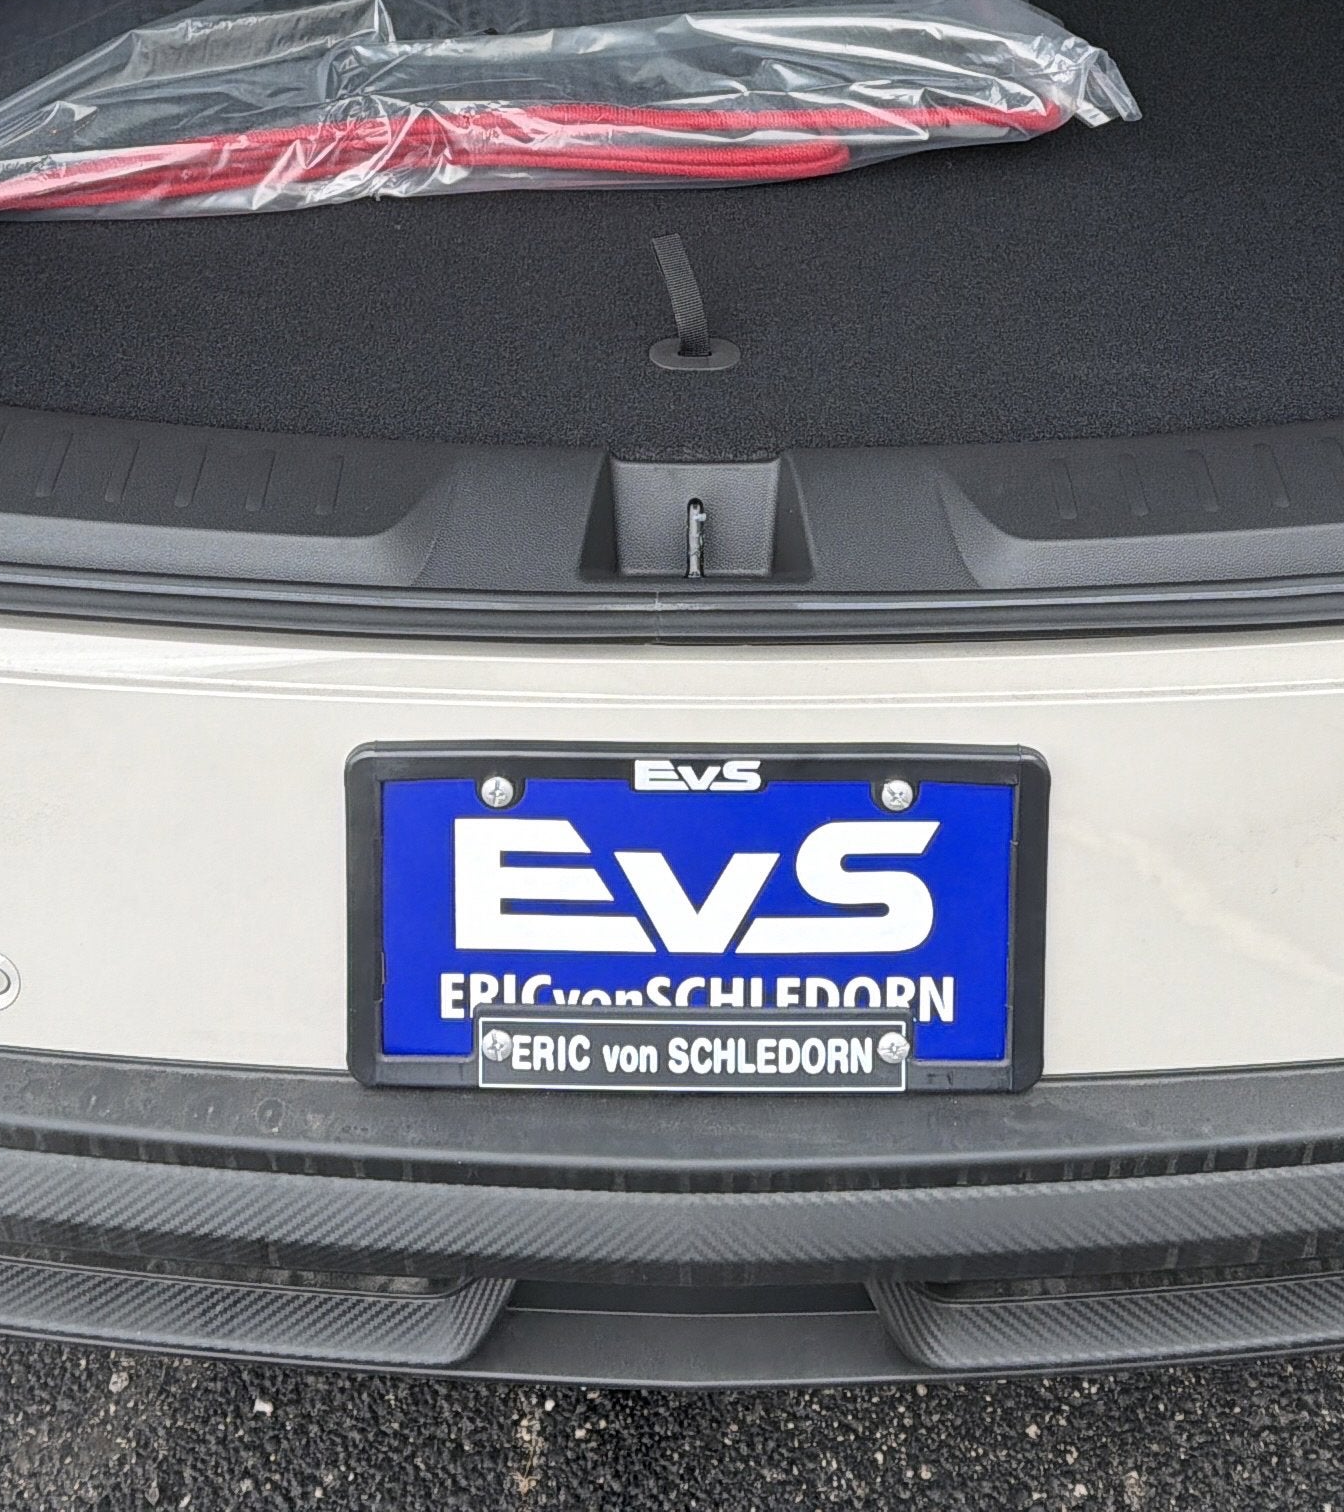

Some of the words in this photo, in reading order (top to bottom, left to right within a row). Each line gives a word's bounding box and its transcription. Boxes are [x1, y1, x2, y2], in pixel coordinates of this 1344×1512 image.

[511, 1034, 591, 1073] ERIC
[602, 1042, 658, 1073] von
[668, 1037, 873, 1075] SCHLEDORN
